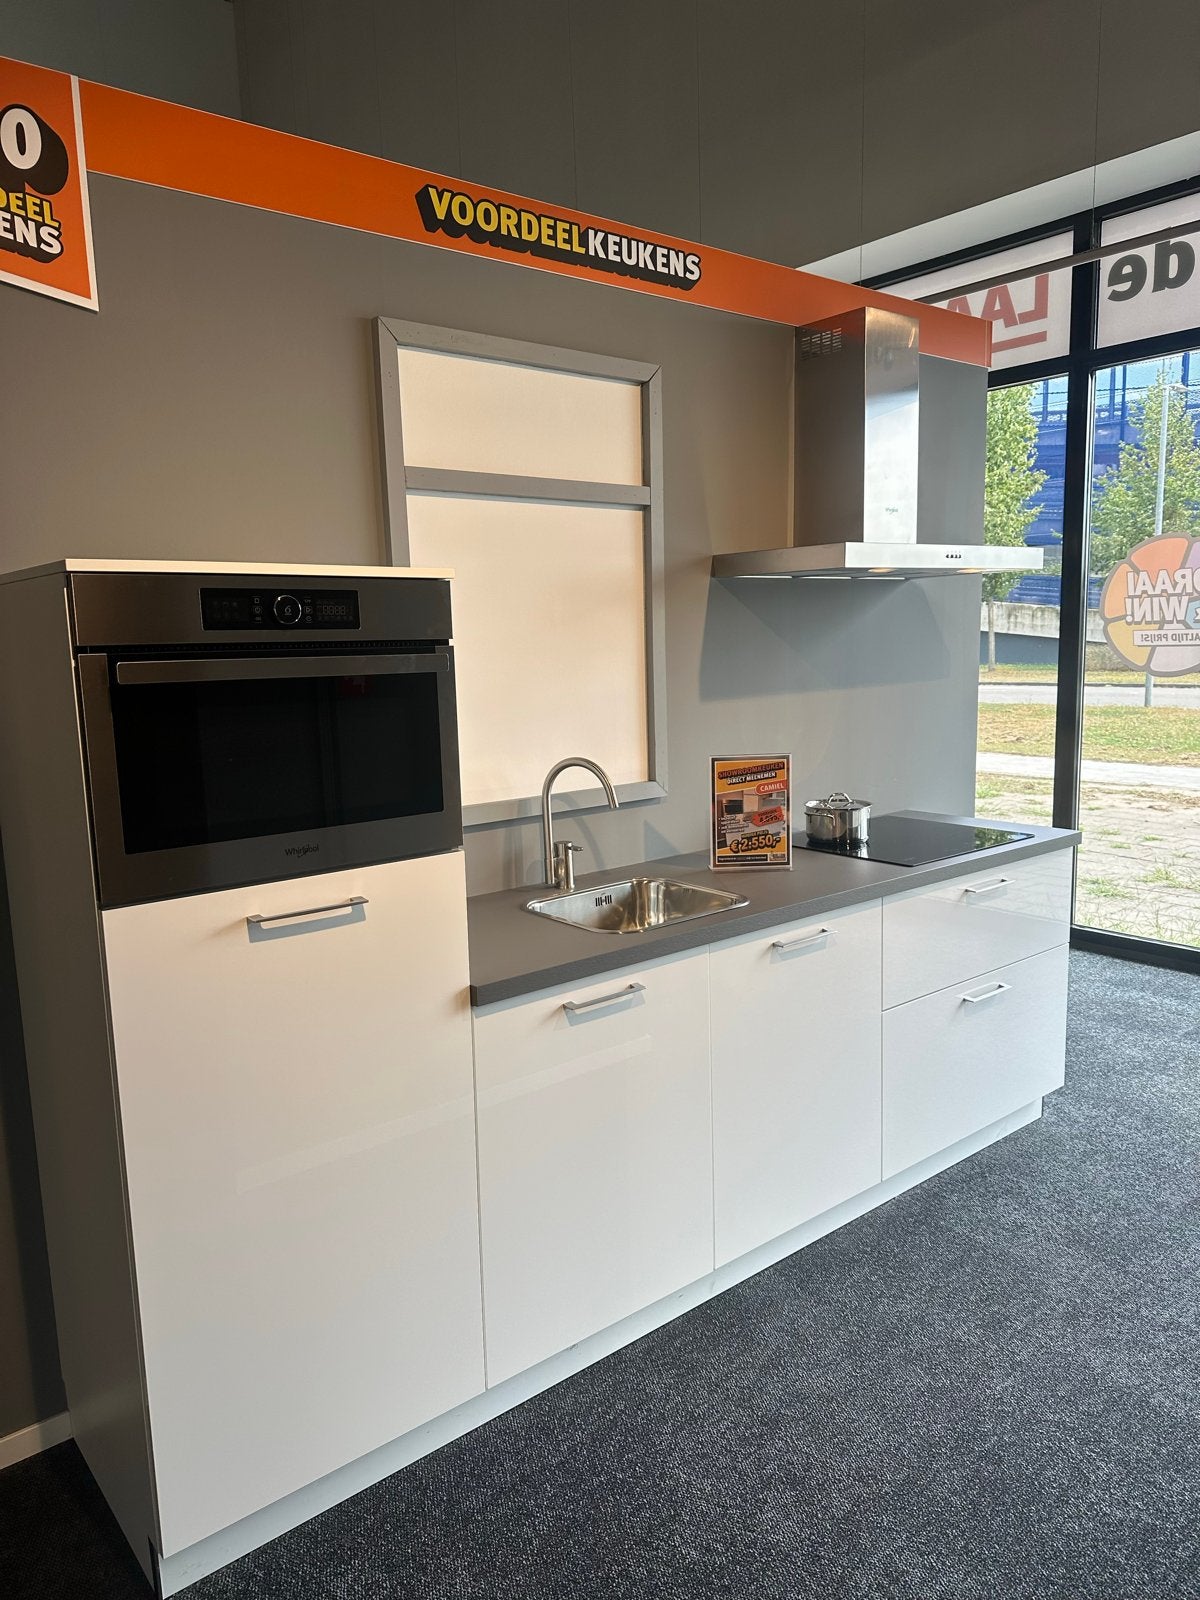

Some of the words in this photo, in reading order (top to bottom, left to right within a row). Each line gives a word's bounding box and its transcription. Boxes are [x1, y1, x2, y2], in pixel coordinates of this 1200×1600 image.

[428, 186, 701, 281] VOORDEELKEUKENS
[760, 783, 785, 792] CAMIEL
[284, 843, 319, 857] Whirlpool
